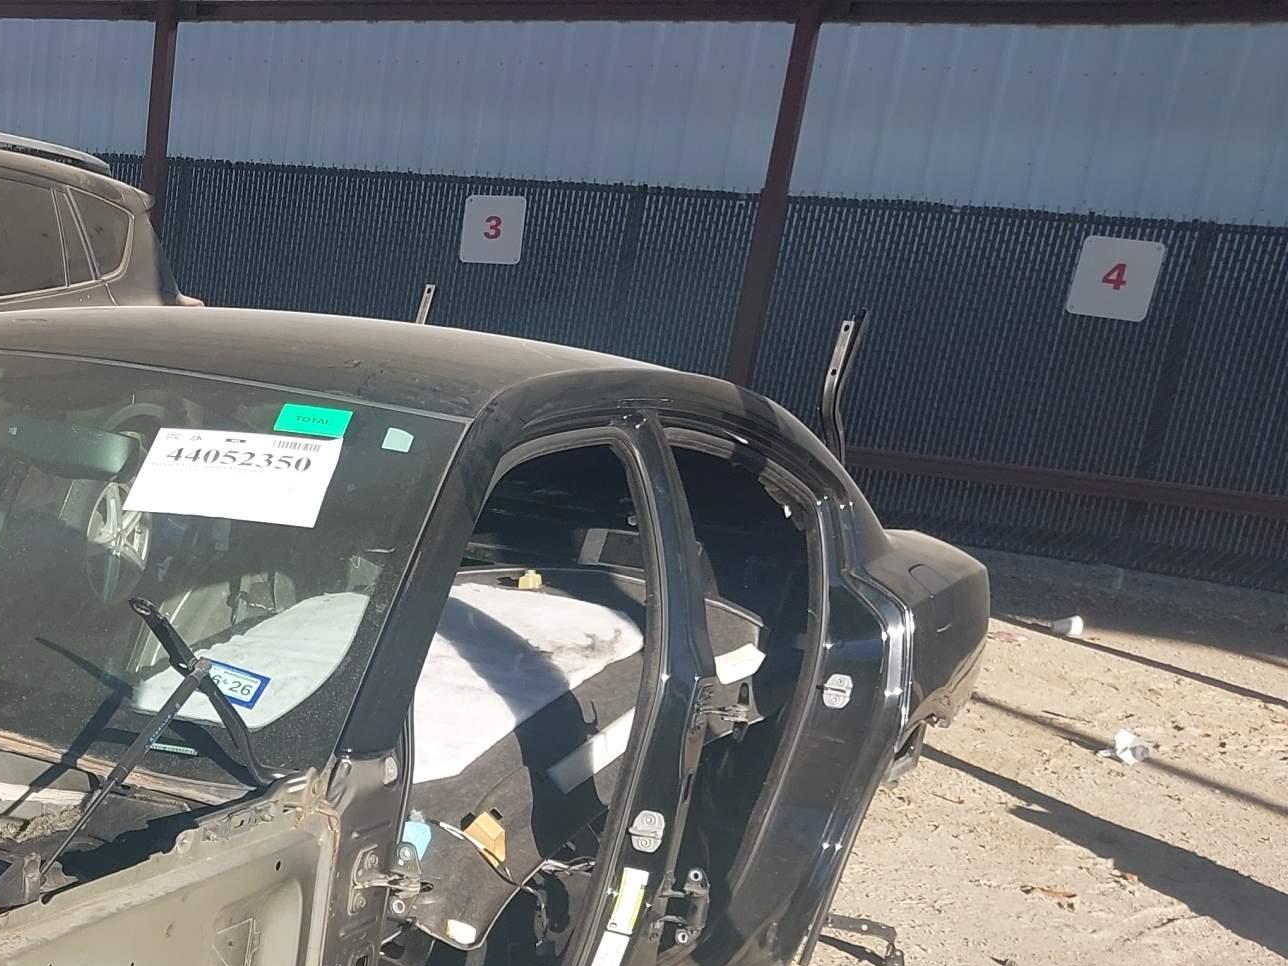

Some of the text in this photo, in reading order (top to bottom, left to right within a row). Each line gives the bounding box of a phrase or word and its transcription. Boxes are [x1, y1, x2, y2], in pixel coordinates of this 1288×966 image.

[483, 215, 503, 240] 3
[1101, 262, 1128, 291] 4
[295, 415, 332, 426] TOTAL
[165, 446, 313, 473] 44052350
[227, 680, 254, 696] 26
